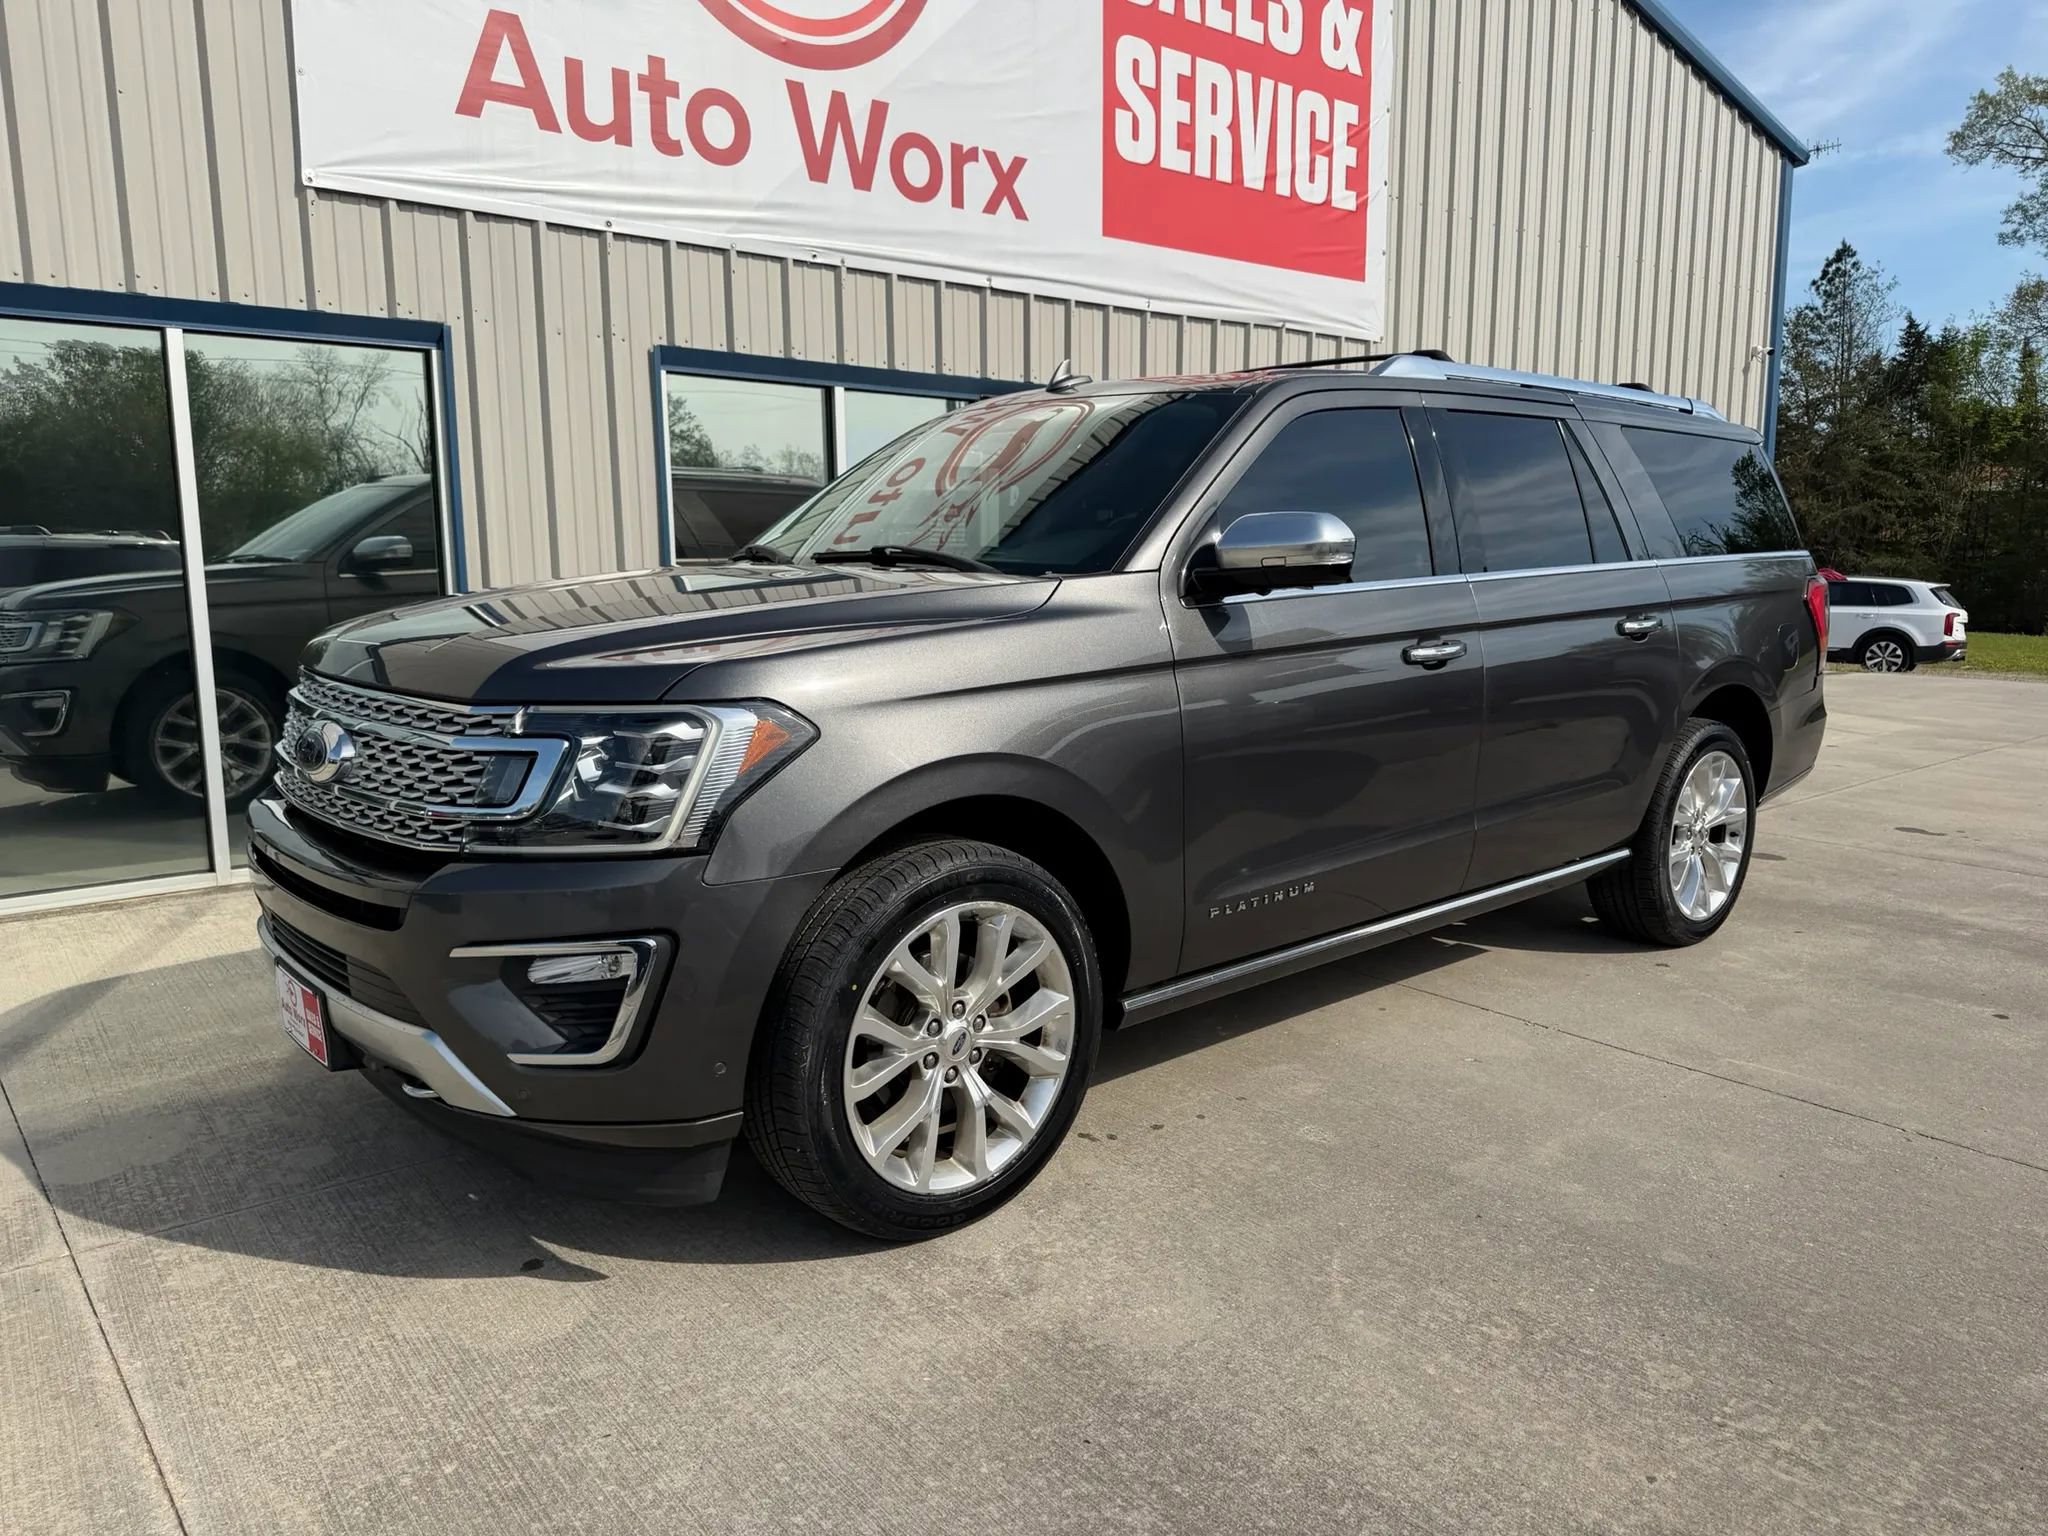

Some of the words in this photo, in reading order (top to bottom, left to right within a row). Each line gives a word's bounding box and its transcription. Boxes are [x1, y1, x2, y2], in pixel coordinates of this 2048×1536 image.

[455, 9, 752, 167] Auto
[785, 79, 1029, 222] Worx
[1114, 33, 1360, 212] SERVICE
[1209, 881, 1315, 919] PLATINUM
